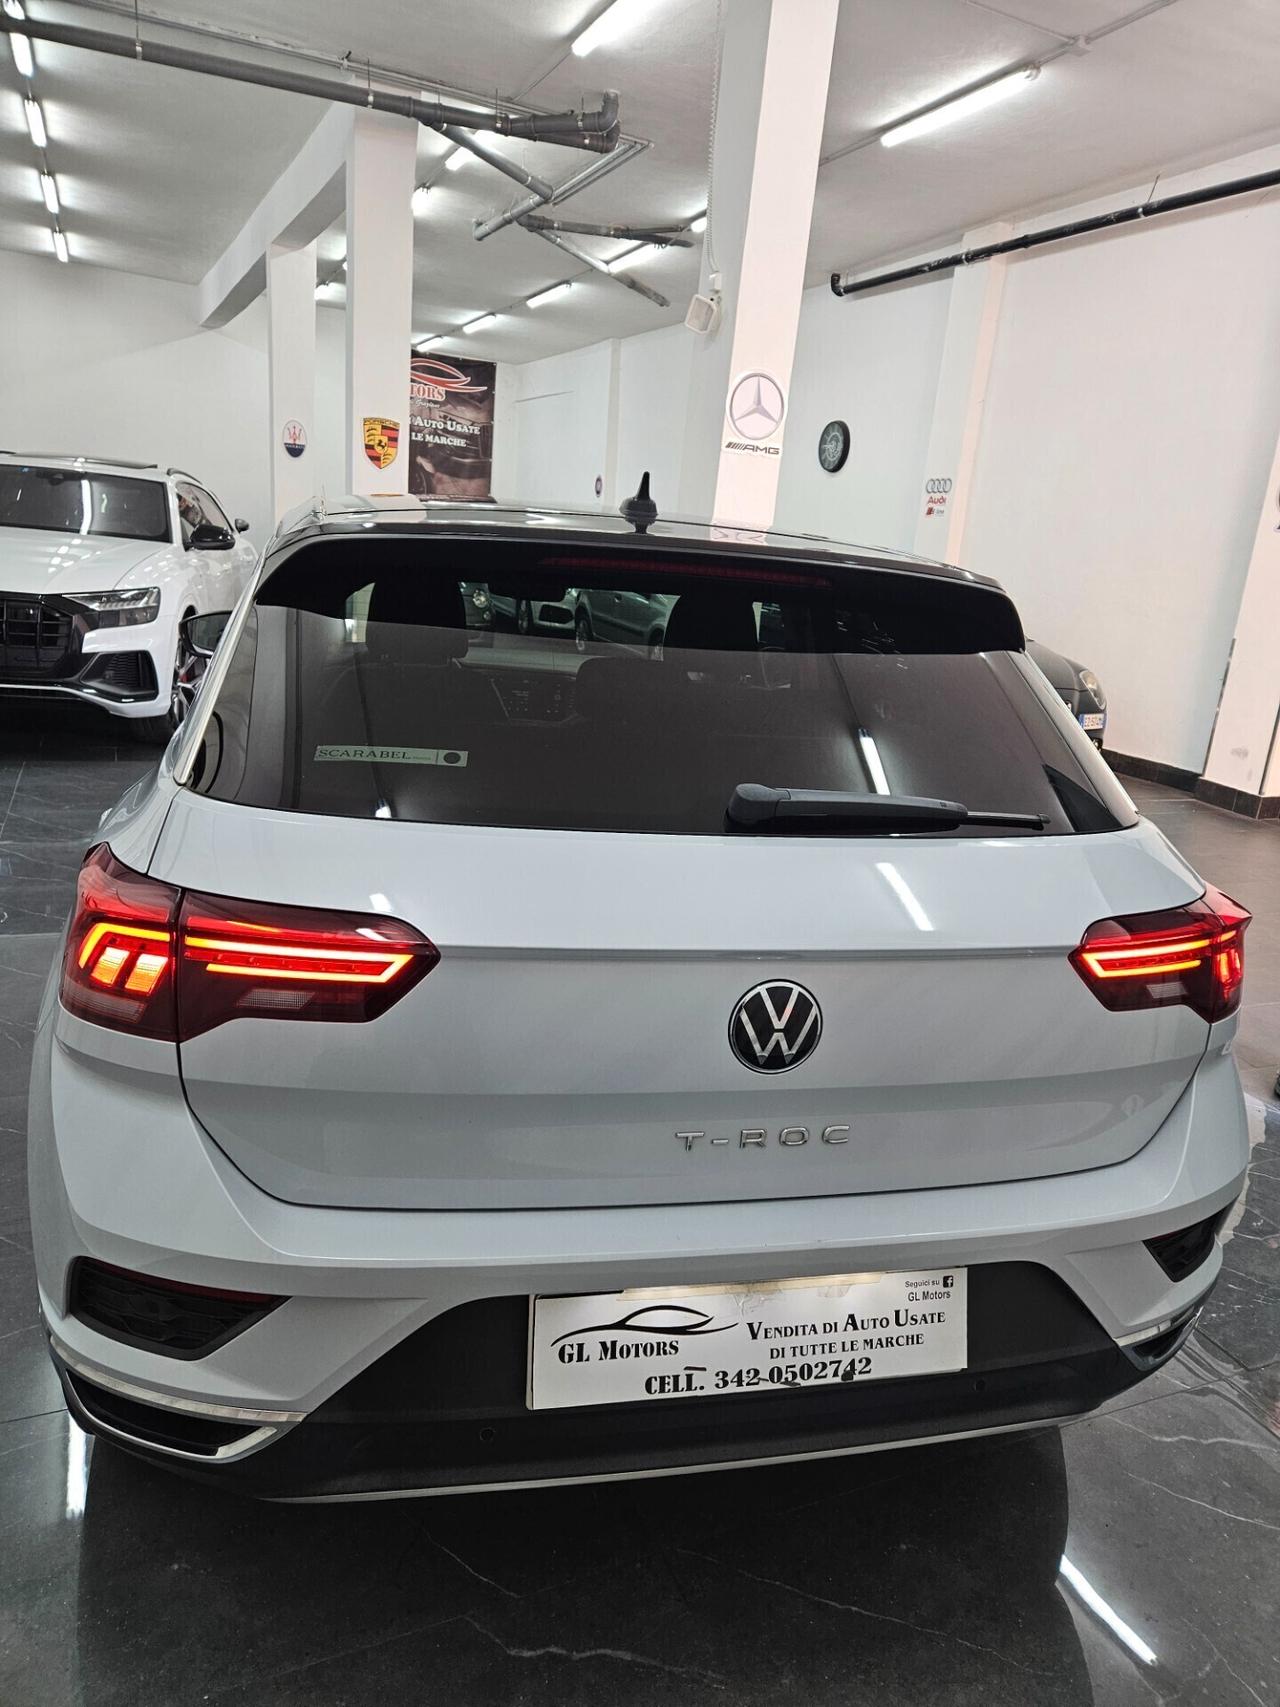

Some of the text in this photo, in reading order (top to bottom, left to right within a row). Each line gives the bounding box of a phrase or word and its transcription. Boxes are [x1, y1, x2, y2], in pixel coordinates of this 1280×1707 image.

[410, 385, 445, 400] TORS
[411, 433, 467, 447] LE MARCHE
[675, 1124, 850, 1151] T-ROC
[905, 1280, 930, 1288] Seguici
[908, 1290, 951, 1302] GL Motors
[823, 1322, 838, 1334] DI
[558, 1343, 590, 1364] GL
[770, 1333, 925, 1359] DI TUTTE LE MARCHE
[645, 1373, 705, 1395] CELL.
